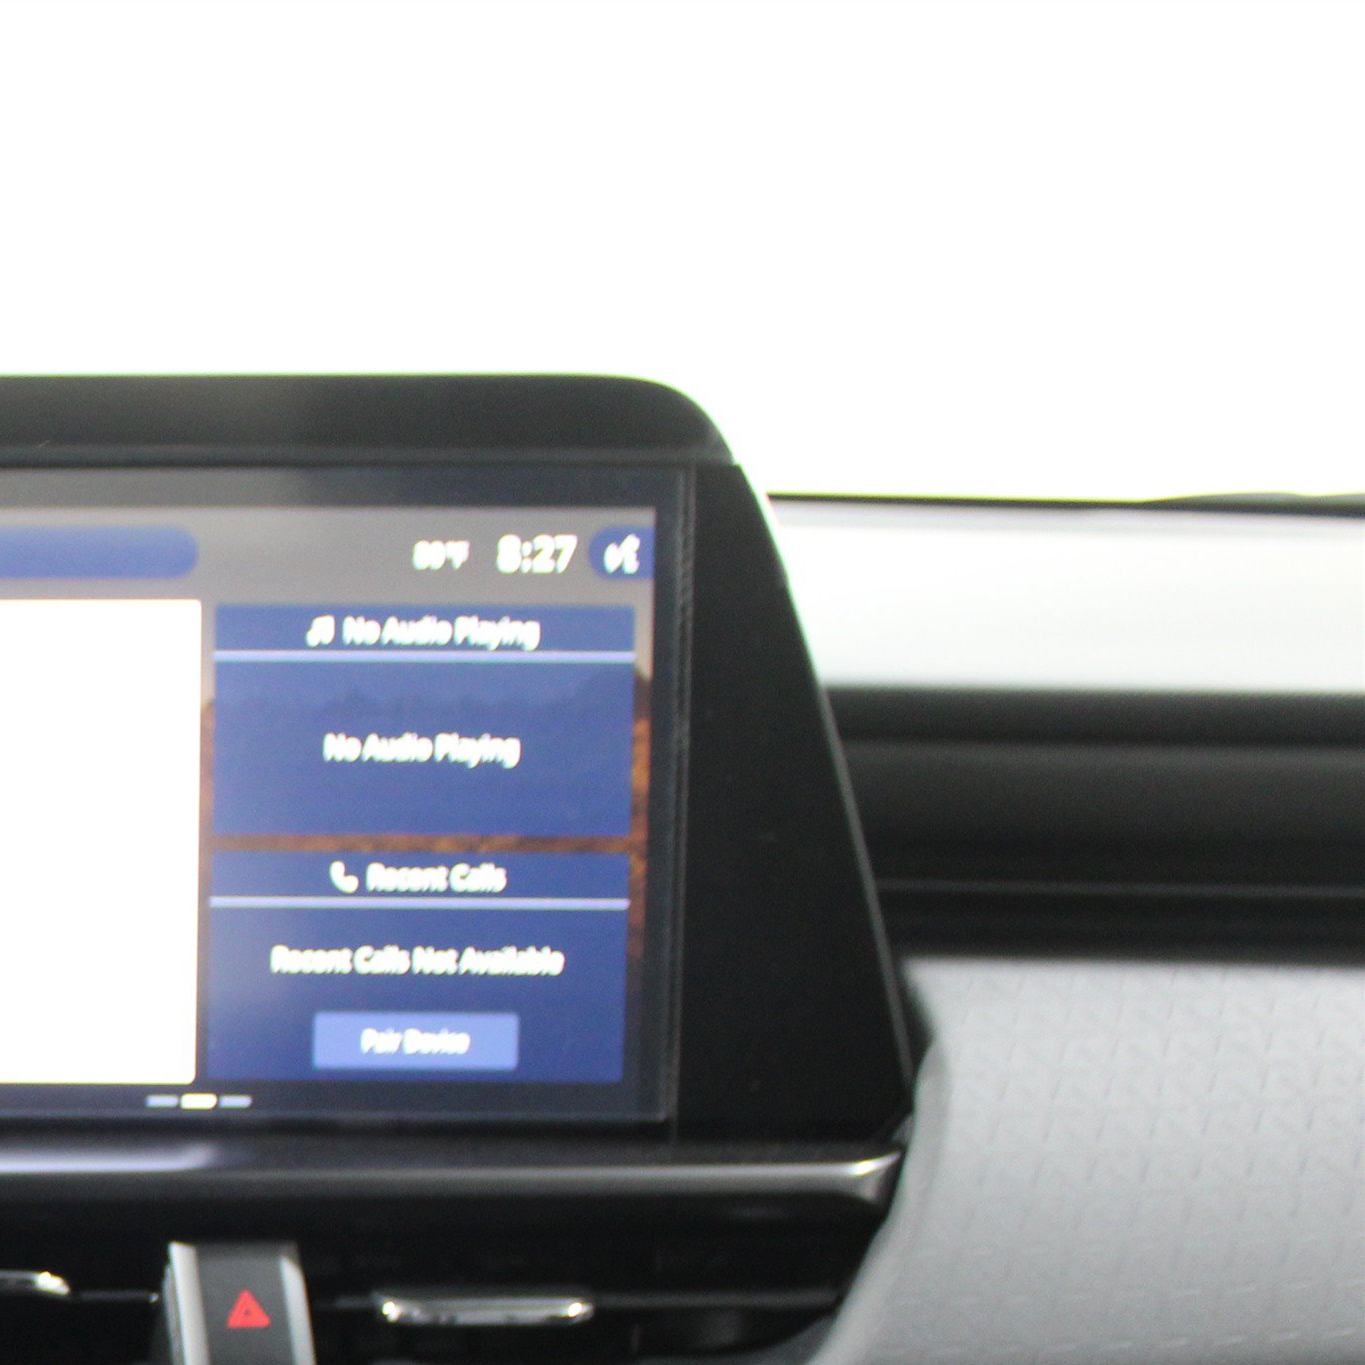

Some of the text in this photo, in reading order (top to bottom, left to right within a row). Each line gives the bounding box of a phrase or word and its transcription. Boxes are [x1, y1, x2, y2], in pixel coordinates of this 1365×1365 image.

[498, 535, 576, 573] 8:27
[343, 616, 540, 651] No Audio Playing
[324, 733, 520, 768] No Audio Playing
[367, 863, 507, 891] Recent Calls
[271, 945, 565, 975] Recent Calls Not Available
[360, 1028, 470, 1055] Pair Device
